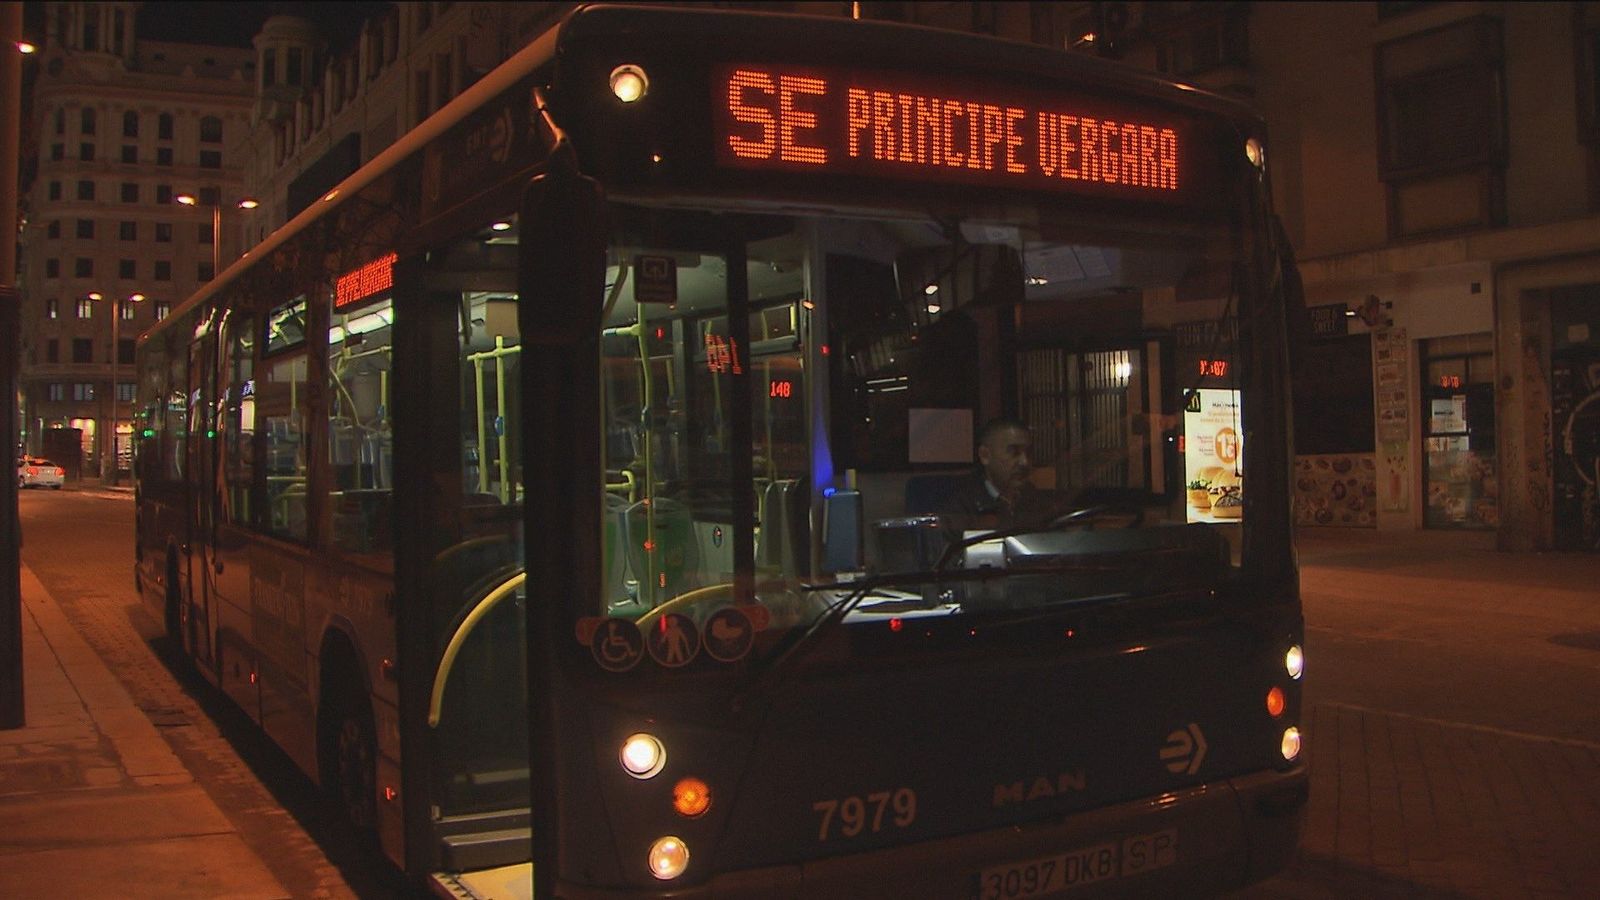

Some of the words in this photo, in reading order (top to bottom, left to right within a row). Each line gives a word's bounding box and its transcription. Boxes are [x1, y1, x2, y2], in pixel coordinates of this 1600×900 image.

[729, 70, 826, 164] SE
[848, 88, 1026, 174] PRINCIPE
[1038, 112, 1177, 190] VERGARA
[771, 381, 790, 397] 148
[813, 788, 917, 841] 7979
[992, 773, 1087, 807] MAN
[988, 860, 1056, 899] 3097
[1064, 849, 1112, 884] DKB
[1129, 835, 1171, 869] SP
